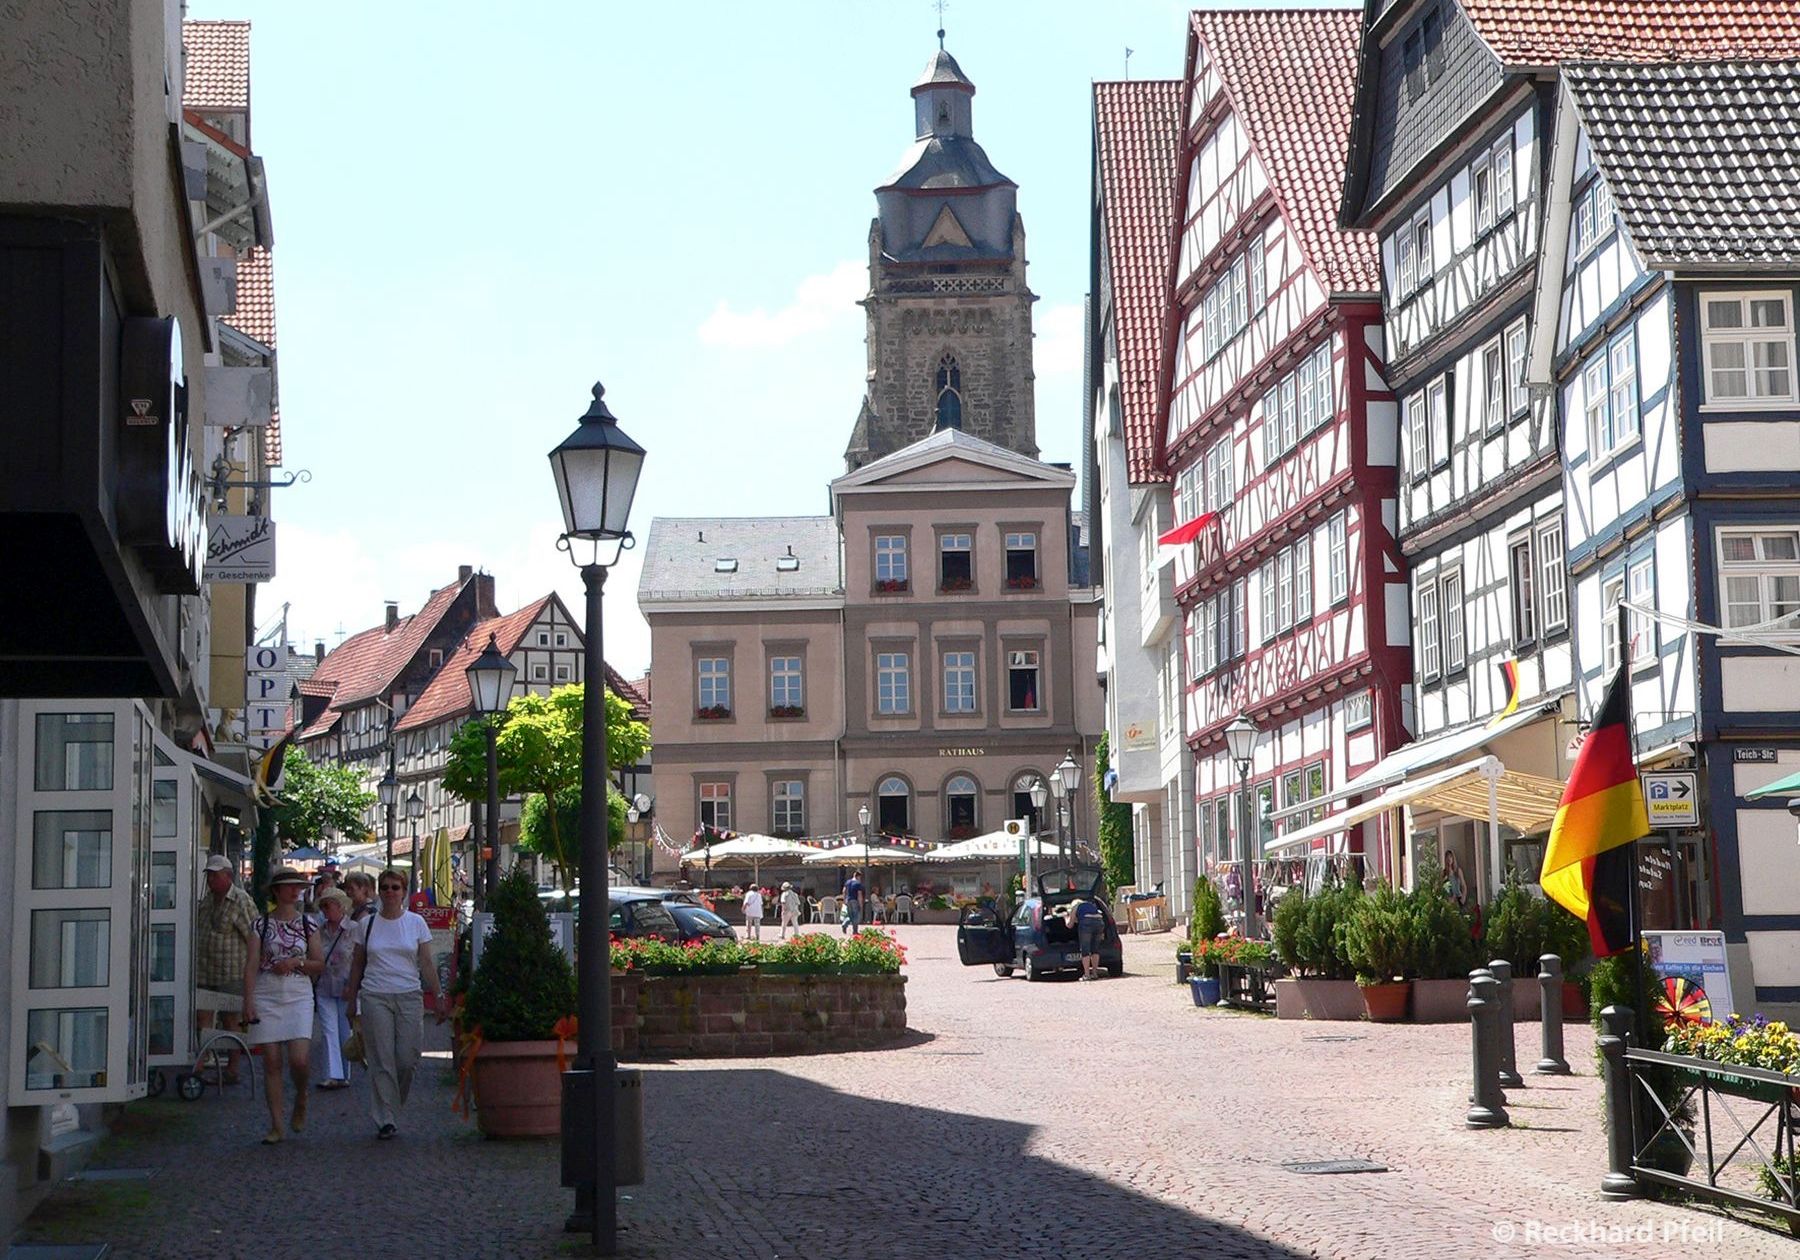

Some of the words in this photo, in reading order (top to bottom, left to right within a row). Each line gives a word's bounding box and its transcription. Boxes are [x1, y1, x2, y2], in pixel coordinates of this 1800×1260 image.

[207, 517, 269, 559] Schmidt
[218, 571, 270, 579] Geschenke
[256, 649, 277, 749] OPTI
[939, 747, 985, 757] RATHAUS
[1654, 787, 1664, 798] P
[1653, 802, 1689, 811] Marktplatz
